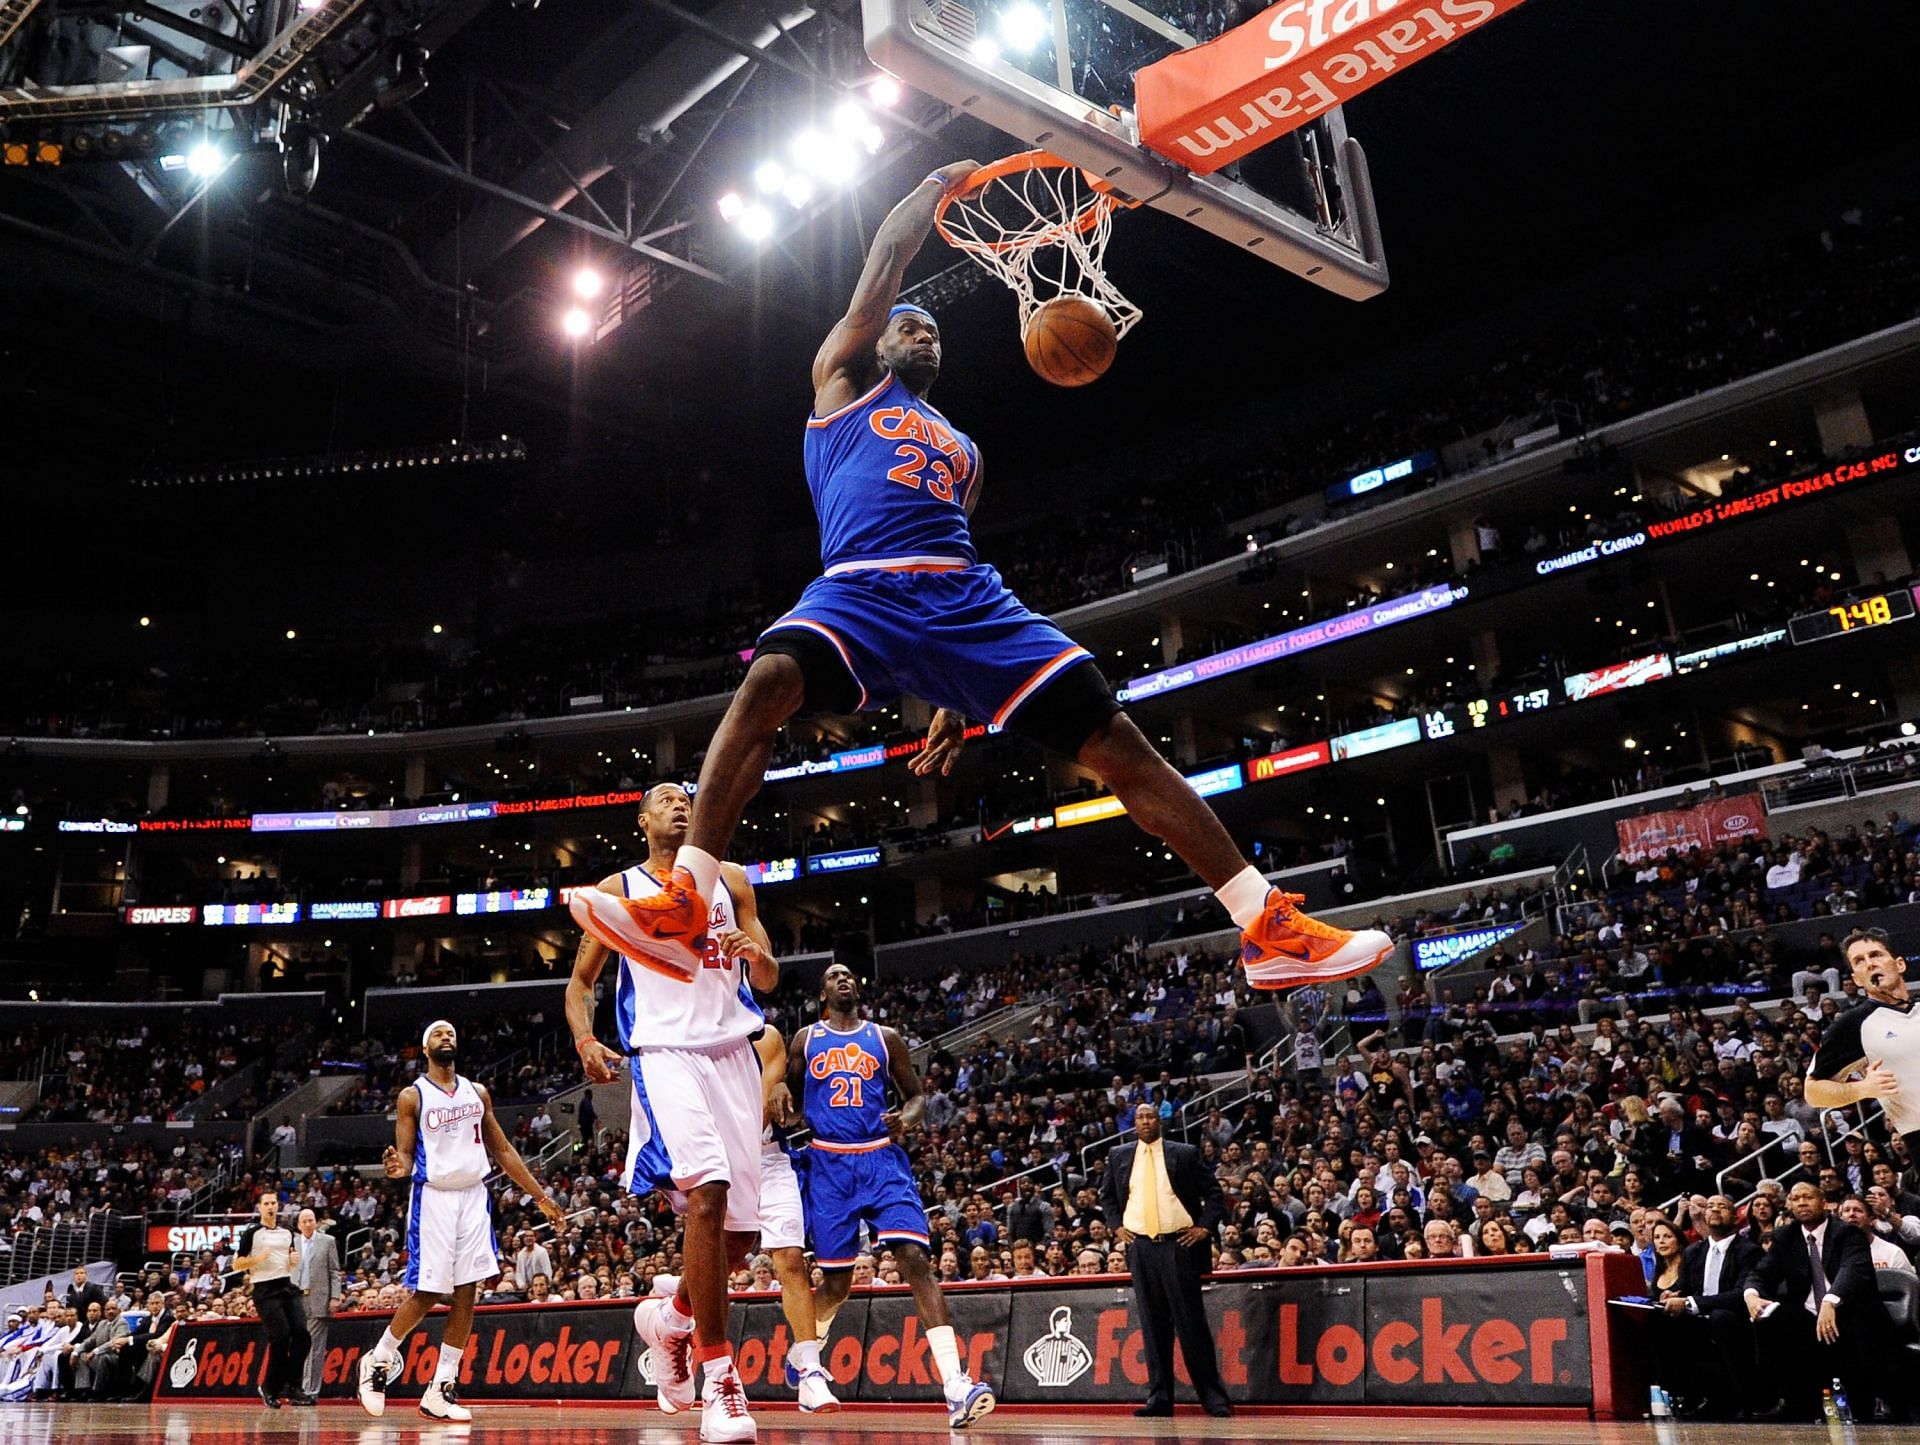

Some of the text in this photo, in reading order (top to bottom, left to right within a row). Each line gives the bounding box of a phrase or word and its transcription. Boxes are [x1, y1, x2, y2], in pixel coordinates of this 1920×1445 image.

[1264, 0, 1398, 70] Sta
[1176, 0, 1495, 156] State Farm
[887, 444, 954, 502] 23
[1536, 546, 1598, 575] COMMERCE
[1601, 532, 1646, 555] CASINO
[1829, 596, 1892, 632] 7:48
[1162, 670, 1194, 687] CASINO
[1196, 652, 1241, 677] WORLD'S
[1242, 639, 1287, 663] LARGEST
[1289, 628, 1325, 650] POKER
[1325, 614, 1369, 637] CASINO
[1373, 600, 1428, 625] COMMERCE
[1430, 585, 1470, 608] CASINO
[1467, 699, 1489, 717] 10
[1499, 701, 1509, 716] 1
[1512, 688, 1550, 713] 7:57
[1425, 711, 1445, 727] LA
[1427, 720, 1455, 740] CLE
[1472, 713, 1486, 728] 2
[963, 725, 985, 740] SINO
[840, 750, 883, 768] WORLD'S
[820, 854, 879, 869] WACHOVIA
[131, 907, 192, 924] STAPLES
[311, 903, 332, 914] SAN
[338, 902, 378, 913] MANUEL
[1417, 939, 1449, 959] SAN
[810, 1045, 880, 1080] CAVS
[830, 1076, 863, 1107] 21
[473, 1123, 481, 1144] 1
[1093, 1297, 1568, 1386] Fot Locker
[195, 1340, 256, 1387] Foot
[401, 1325, 621, 1385] Fot Locker
